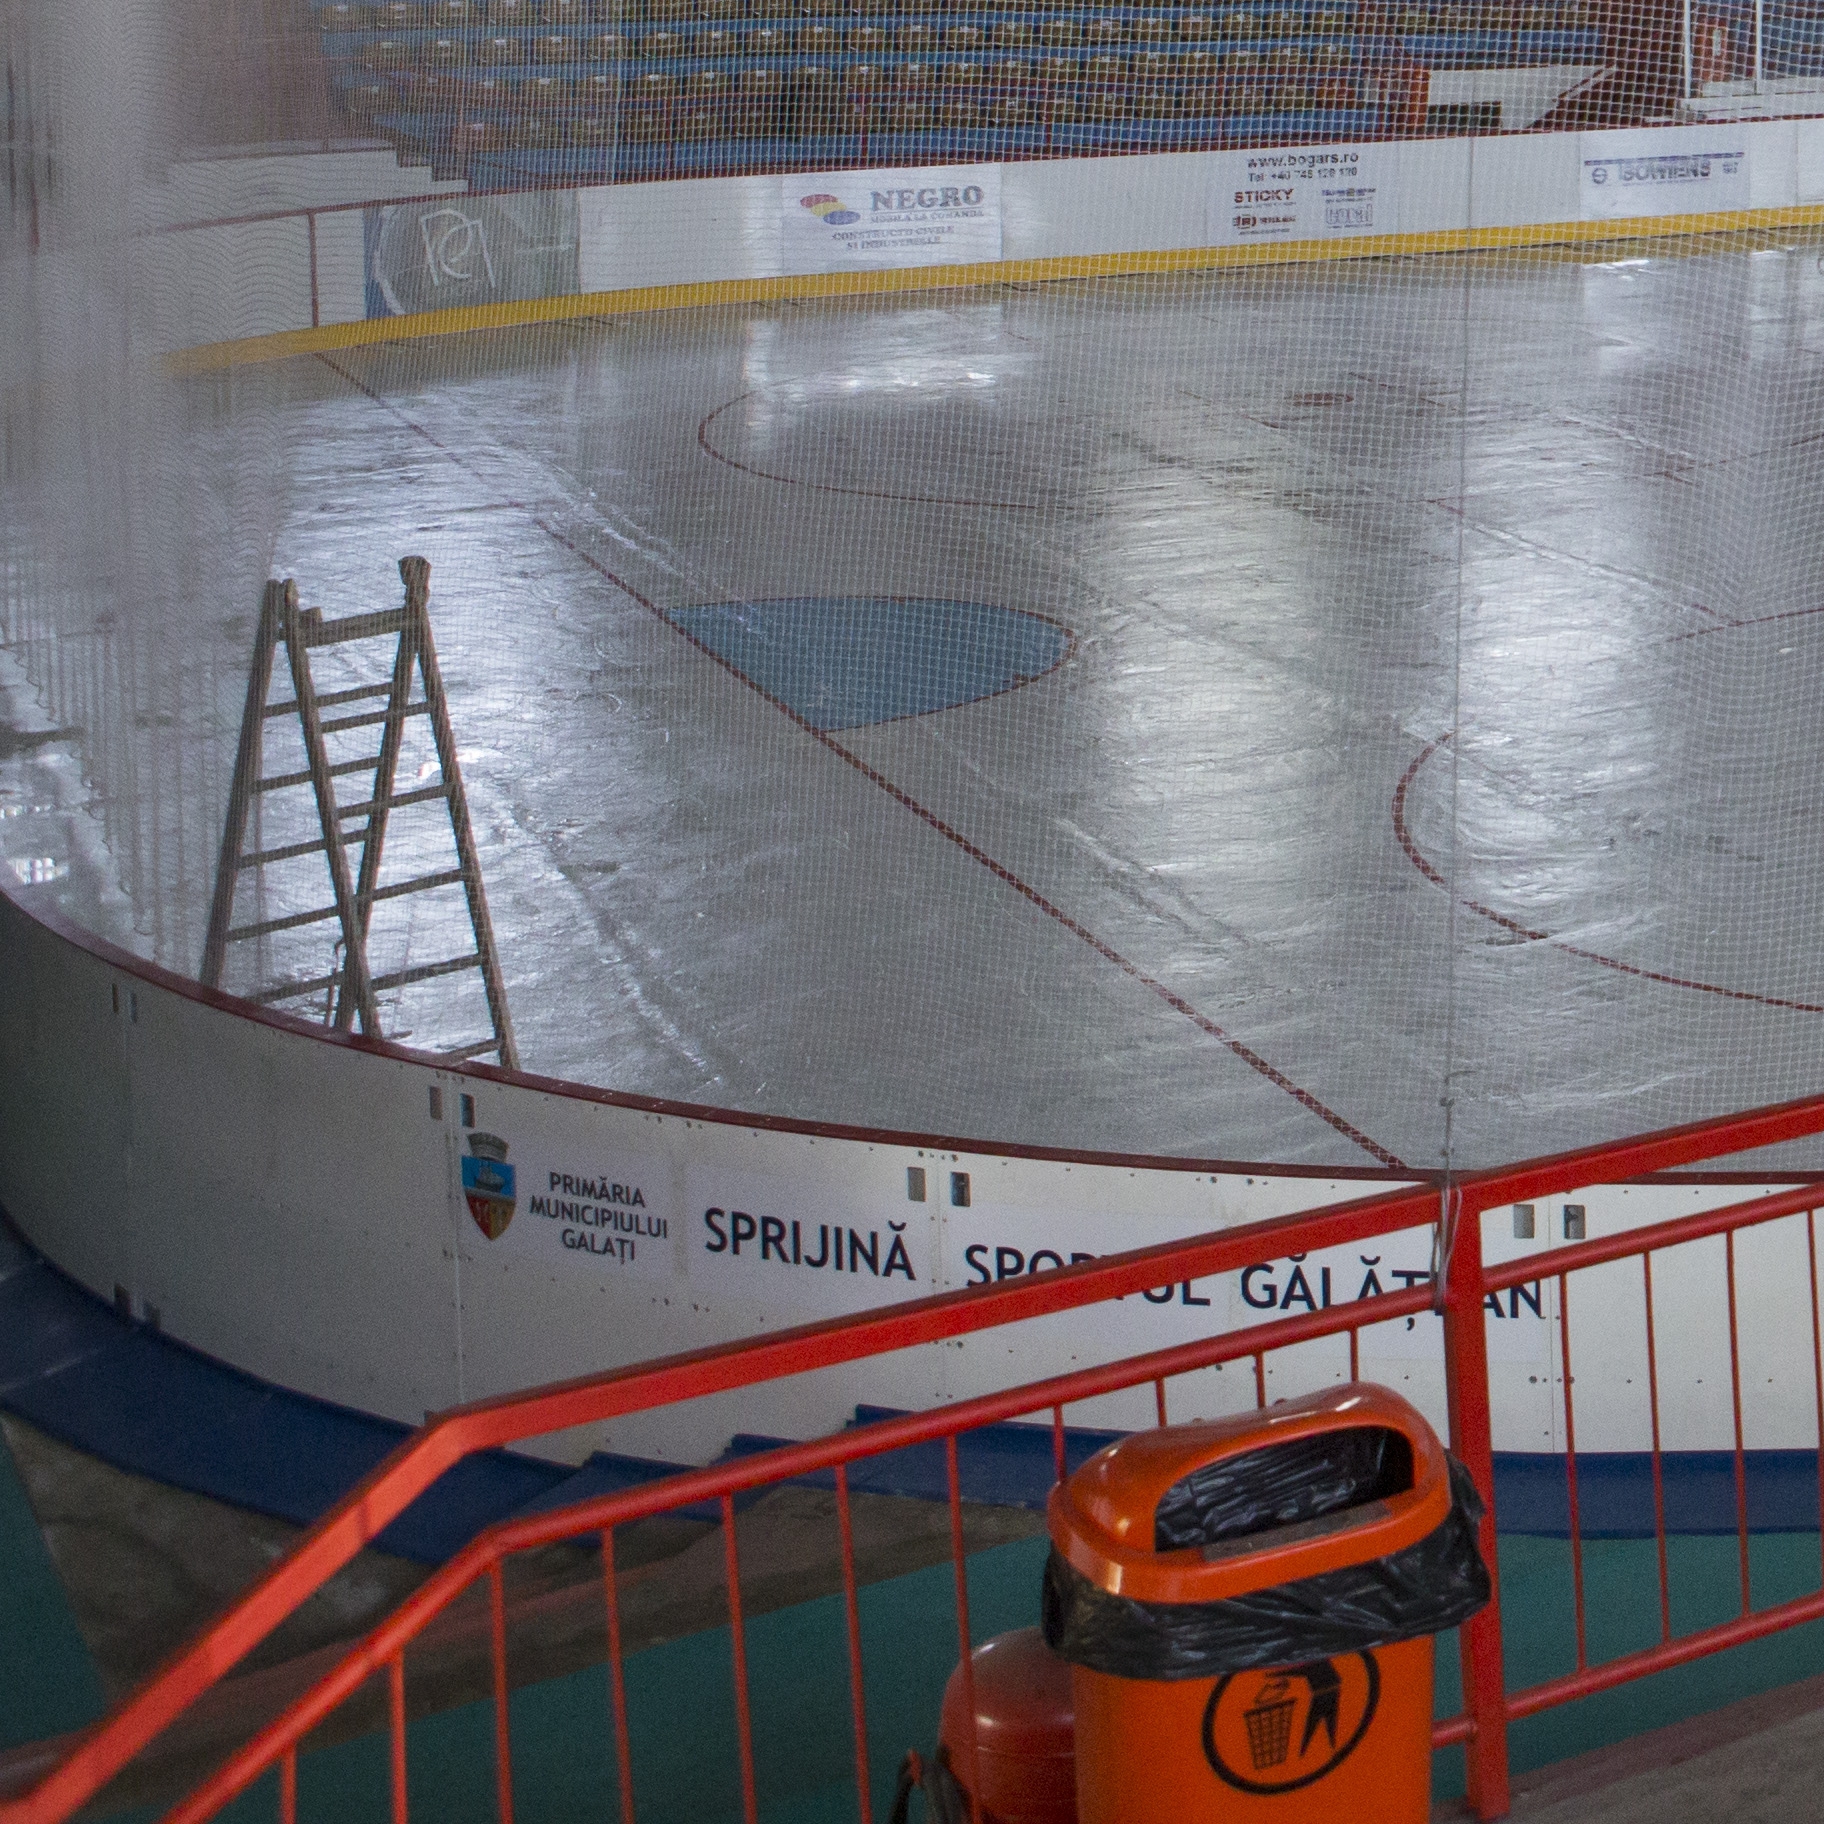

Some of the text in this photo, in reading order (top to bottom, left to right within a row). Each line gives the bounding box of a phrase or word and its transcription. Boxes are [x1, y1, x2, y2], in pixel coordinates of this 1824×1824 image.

[870, 185, 985, 212] NEGRO
[1234, 188, 1294, 204] STICKY
[549, 1171, 646, 1208] PRIMĂRIA
[529, 1195, 668, 1239] MUNICIPIULUI
[561, 1228, 636, 1265] GALAȚI
[704, 1207, 917, 1281] SPRIJINĂ
